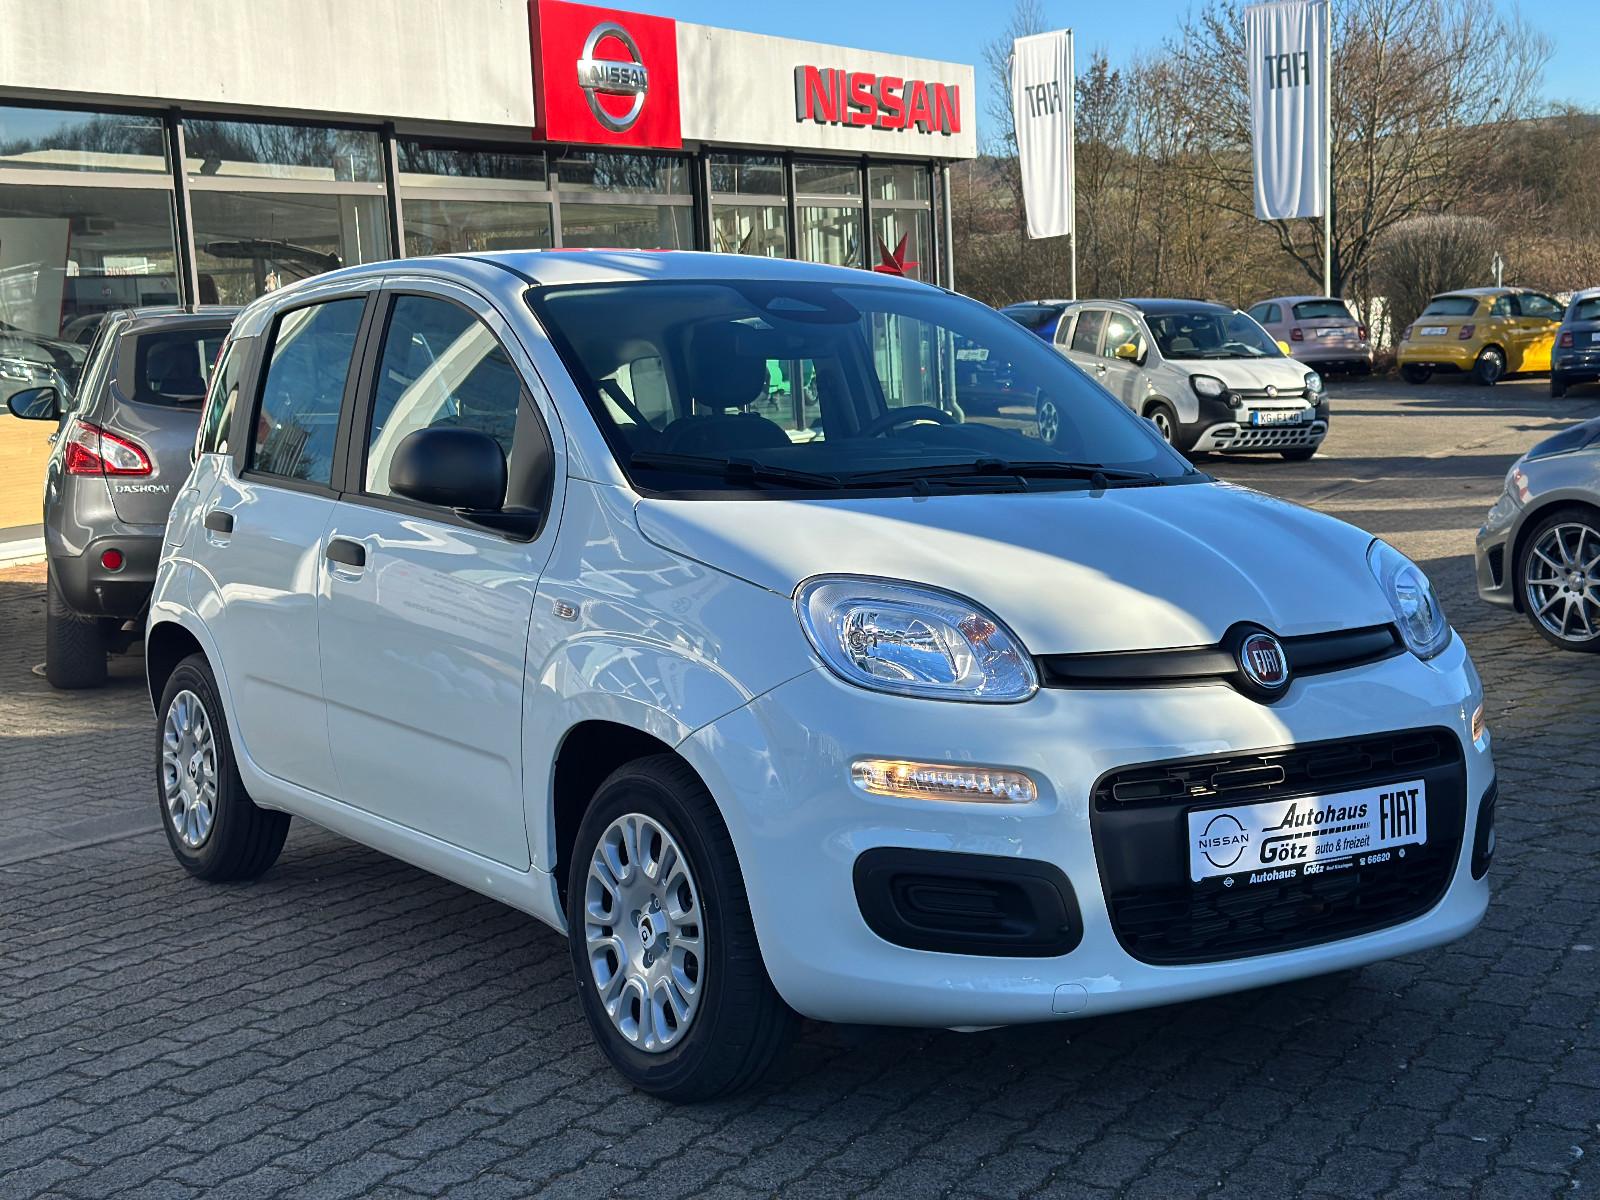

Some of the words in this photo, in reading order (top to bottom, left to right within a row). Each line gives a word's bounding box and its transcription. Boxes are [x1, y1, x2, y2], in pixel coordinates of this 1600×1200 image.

[590, 65, 647, 86] NISSAN
[795, 65, 961, 135] NISSAN
[1252, 649, 1279, 674] FIAT
[1262, 803, 1368, 832] Autohaus
[1379, 788, 1419, 841] FIAT
[1199, 833, 1249, 849] NISSAN
[1260, 834, 1308, 864] Götz
[1315, 842, 1335, 855] auto
[1335, 838, 1342, 852] &
[1343, 834, 1371, 852] freizeit
[1249, 868, 1297, 884] Autohaus
[1303, 862, 1325, 876] Götz
[1367, 852, 1391, 864] 66620
